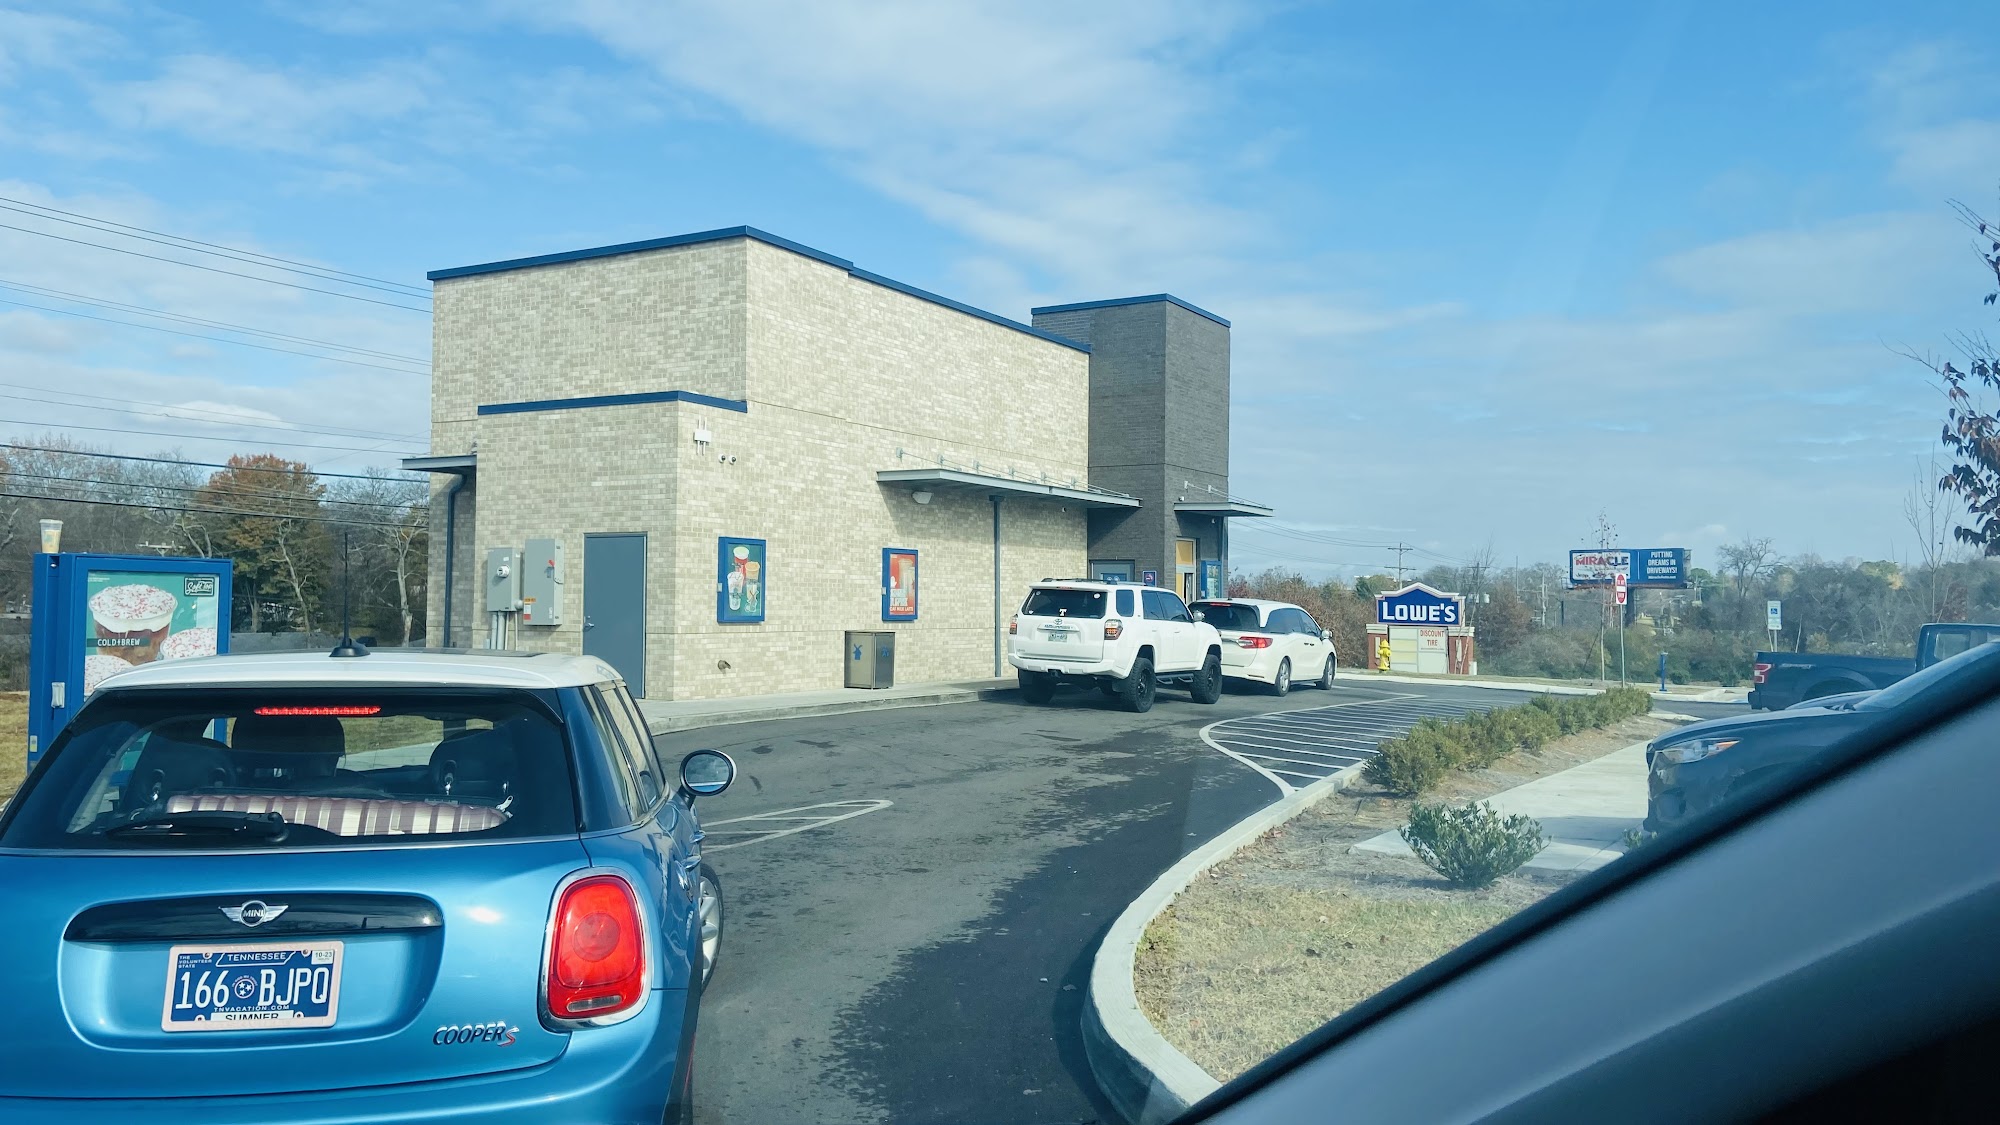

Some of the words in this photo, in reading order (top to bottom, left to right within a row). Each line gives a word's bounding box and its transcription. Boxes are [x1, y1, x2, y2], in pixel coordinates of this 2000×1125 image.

[1576, 556, 1629, 566] MIRACLE
[1059, 608, 1067, 616] T
[1382, 601, 1456, 622] LOWE'S
[1420, 629, 1445, 637] DISCOUNT
[97, 638, 117, 646] COLD
[121, 638, 140, 646] BREW
[243, 909, 264, 917] MINI
[227, 952, 287, 962] TENNESSEE
[175, 970, 230, 1009] 166
[258, 967, 330, 1006] BJPQ
[213, 1004, 290, 1012] TNVACATION.COM
[225, 1012, 279, 1020] SUMNER
[432, 1020, 507, 1045] COOPER
[497, 1025, 520, 1047] S
